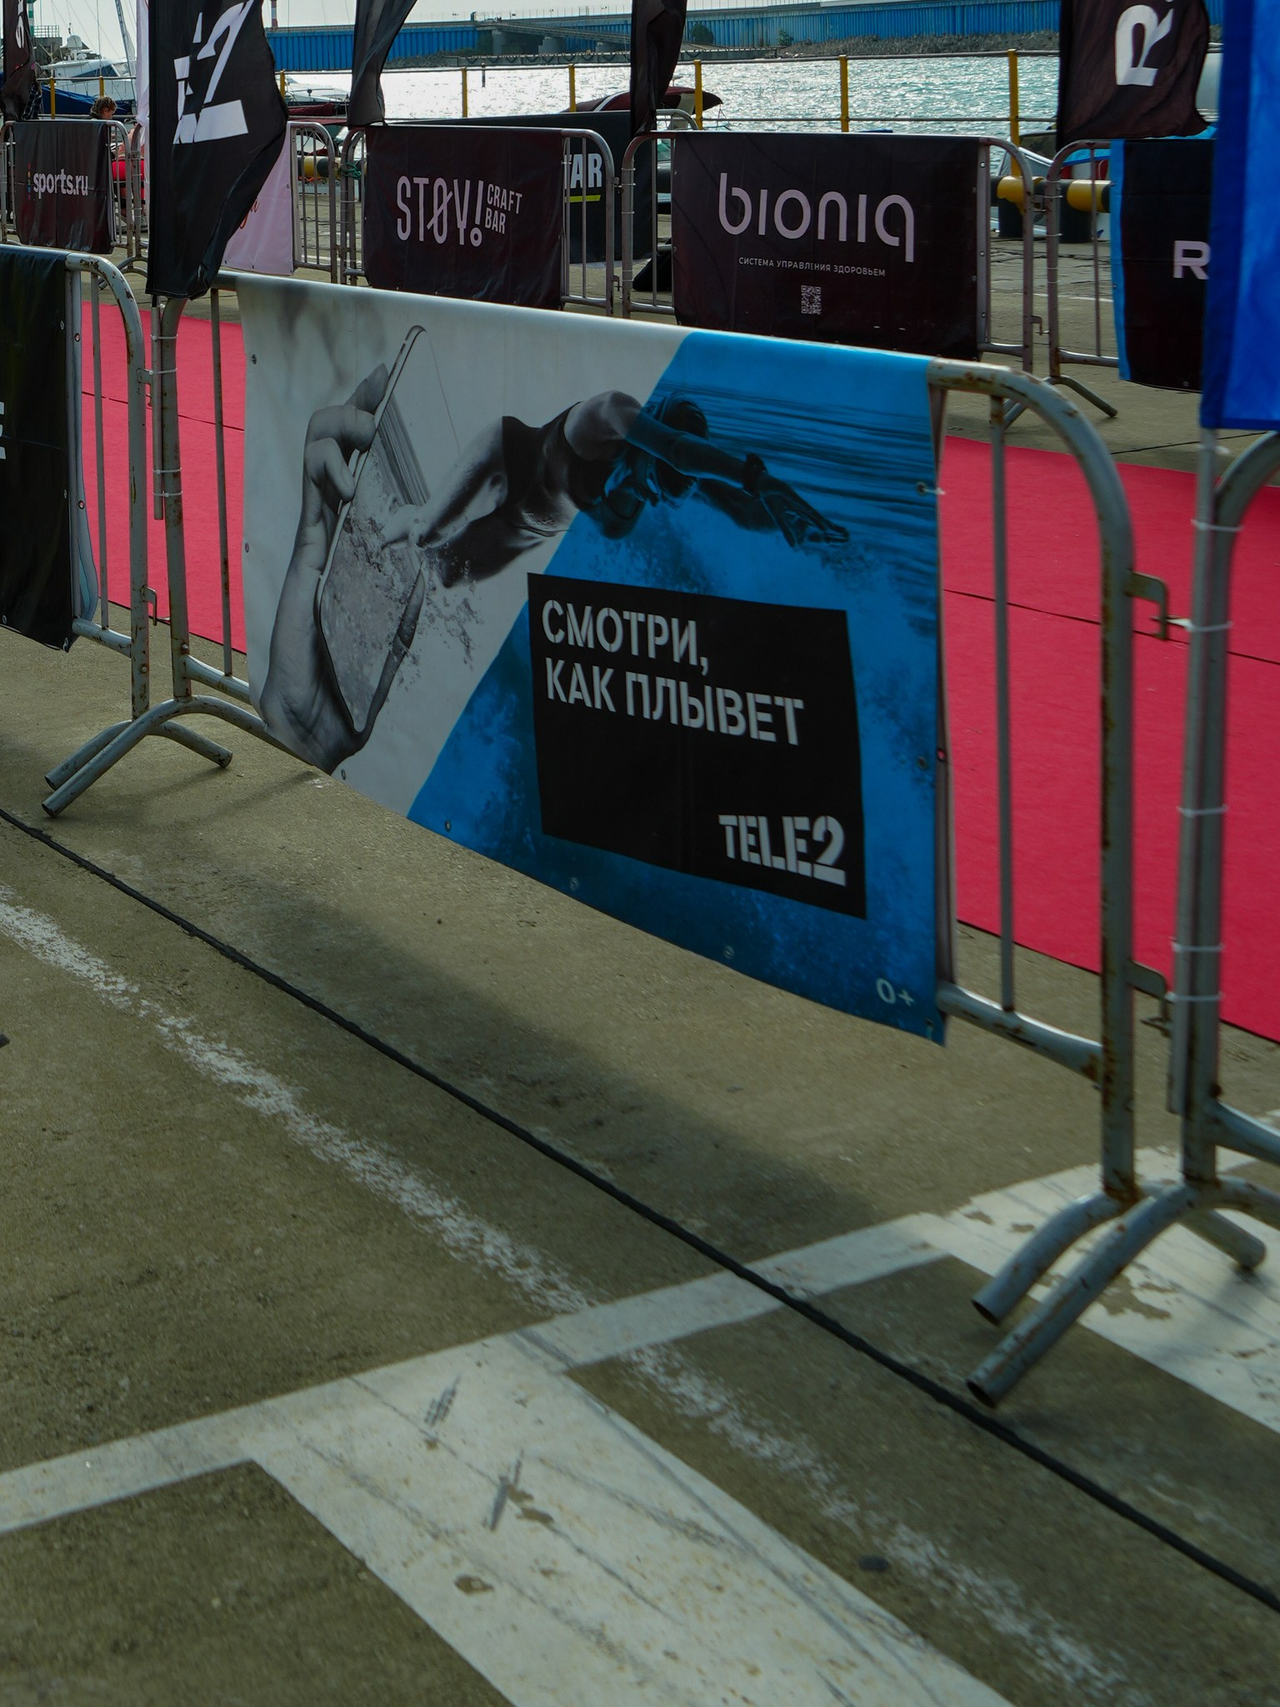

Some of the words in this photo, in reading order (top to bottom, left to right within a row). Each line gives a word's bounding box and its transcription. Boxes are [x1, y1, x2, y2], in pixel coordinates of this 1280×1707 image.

[33, 168, 89, 200] sports.ru
[487, 183, 523, 215] CRAFT
[485, 207, 506, 235] BAR
[718, 172, 915, 263] bioniq
[738, 256, 775, 268] СИСТЕМА
[776, 259, 832, 273] УПРАВЛЕНИЯ
[833, 264, 886, 278] ЗДОРОВЬЕМ
[541, 599, 709, 676] СМОТРИ,
[545, 657, 616, 713] КАК
[625, 670, 805, 746] ПЛЫВЕТ
[718, 814, 847, 887] TELE2
[876, 978, 916, 1006] 0+
